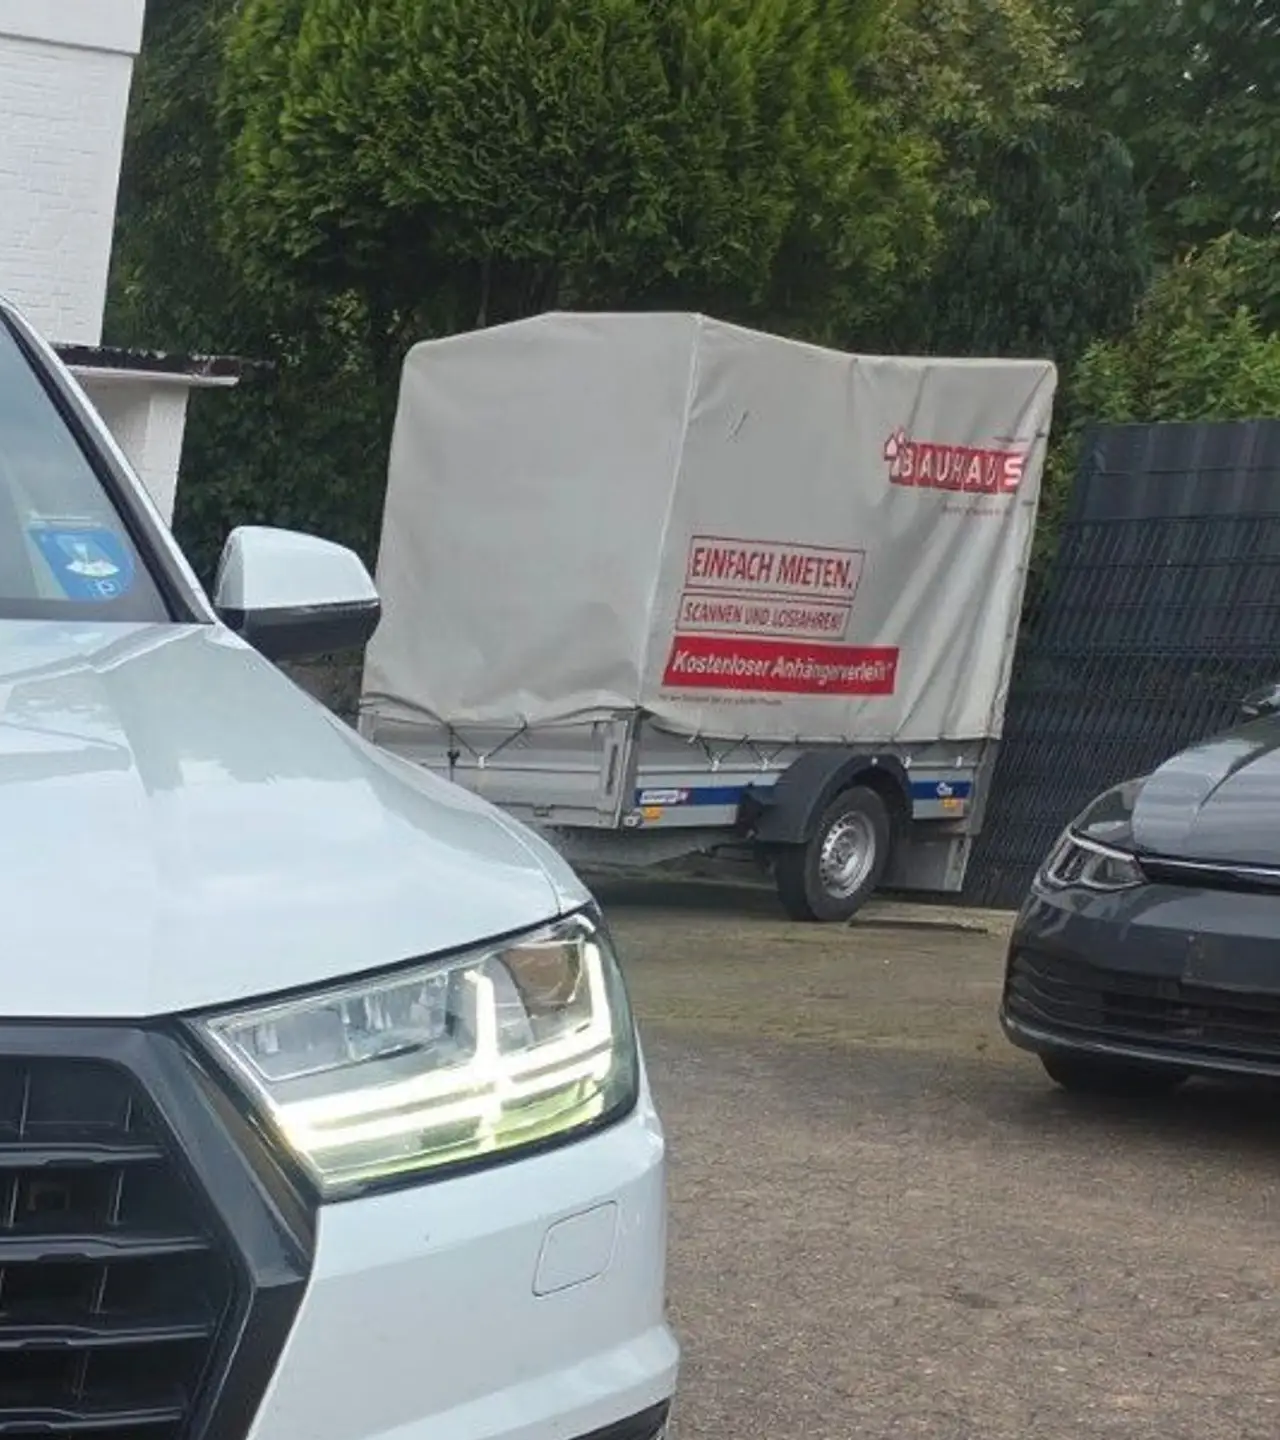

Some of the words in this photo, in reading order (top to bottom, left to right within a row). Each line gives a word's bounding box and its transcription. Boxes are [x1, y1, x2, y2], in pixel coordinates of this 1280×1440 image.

[692, 548, 774, 582] EINFACH
[776, 553, 853, 588] MIETEN.
[683, 602, 743, 623] SCANNEN
[744, 604, 769, 625] UND
[672, 650, 772, 677] Kostenloser
